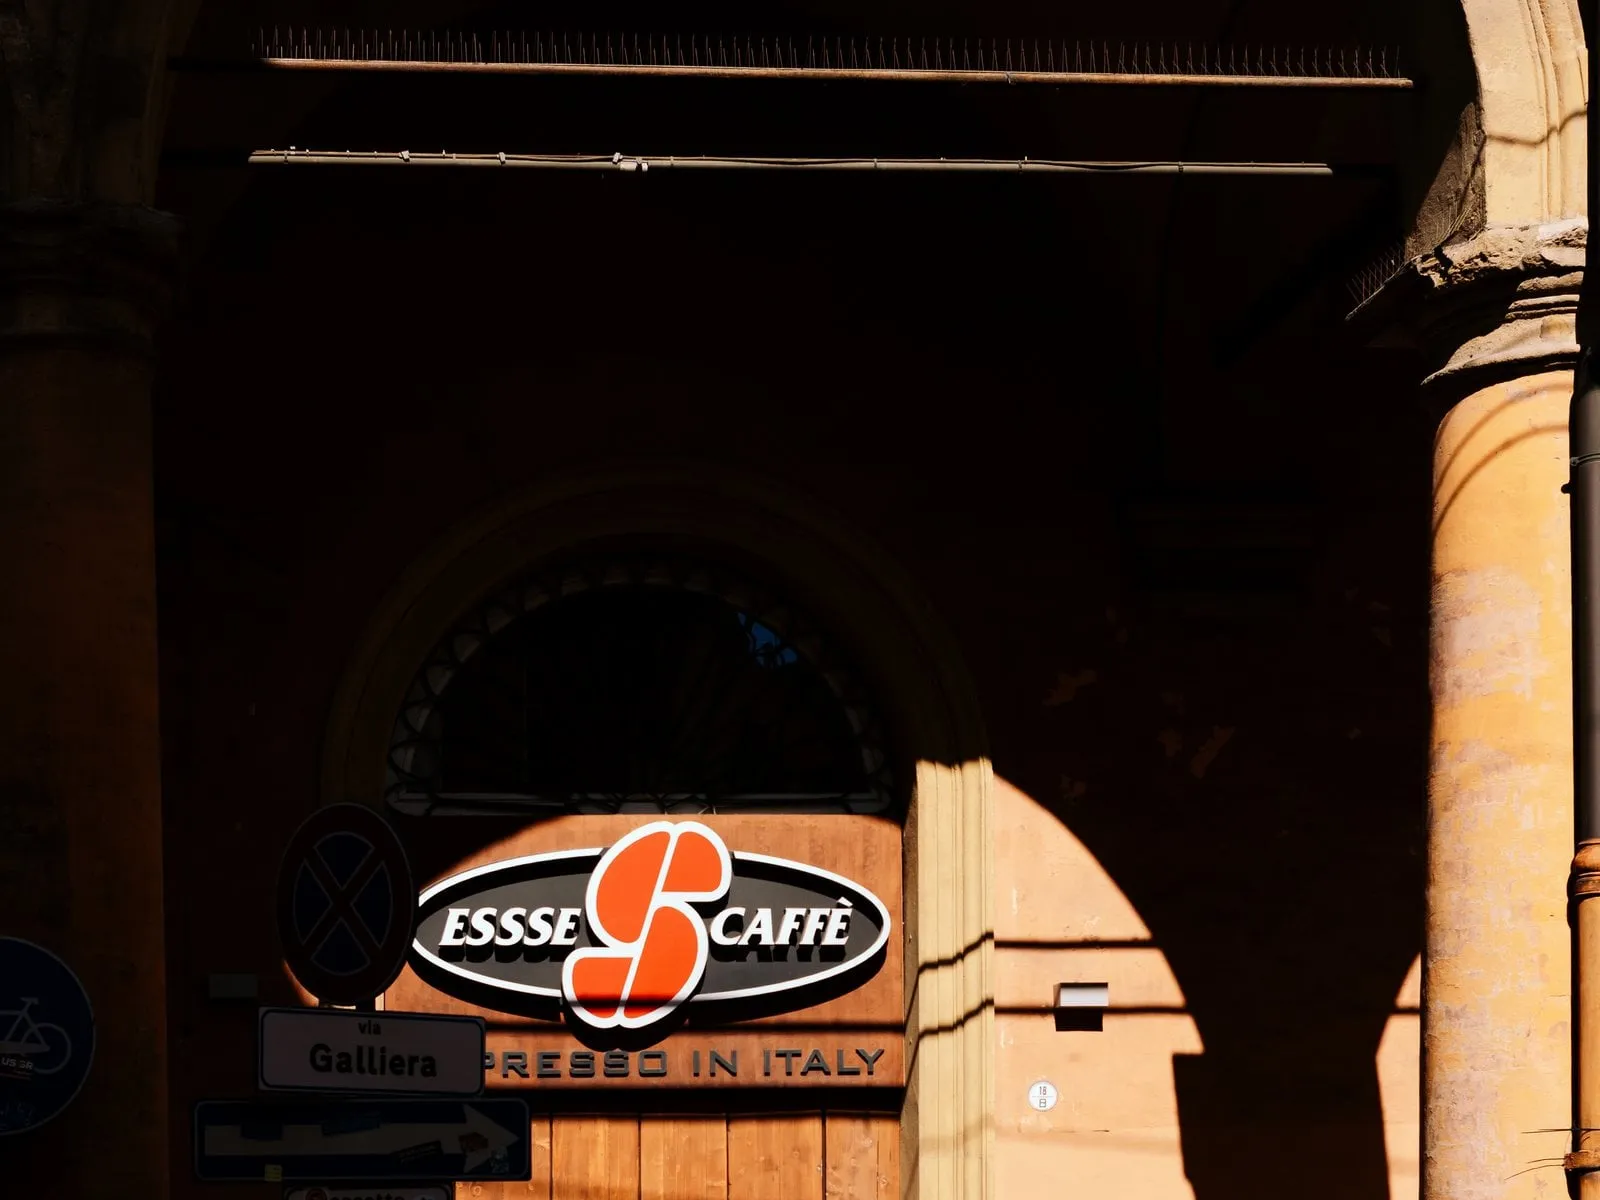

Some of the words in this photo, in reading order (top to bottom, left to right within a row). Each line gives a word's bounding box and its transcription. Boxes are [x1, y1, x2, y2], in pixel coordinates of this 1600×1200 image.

[439, 907, 582, 948] ESSSE
[711, 897, 854, 948] CAFFÈ
[358, 1020, 382, 1035] via
[310, 1043, 437, 1077] Galliera
[693, 1049, 737, 1077] IN
[763, 1049, 885, 1077] ITALY
